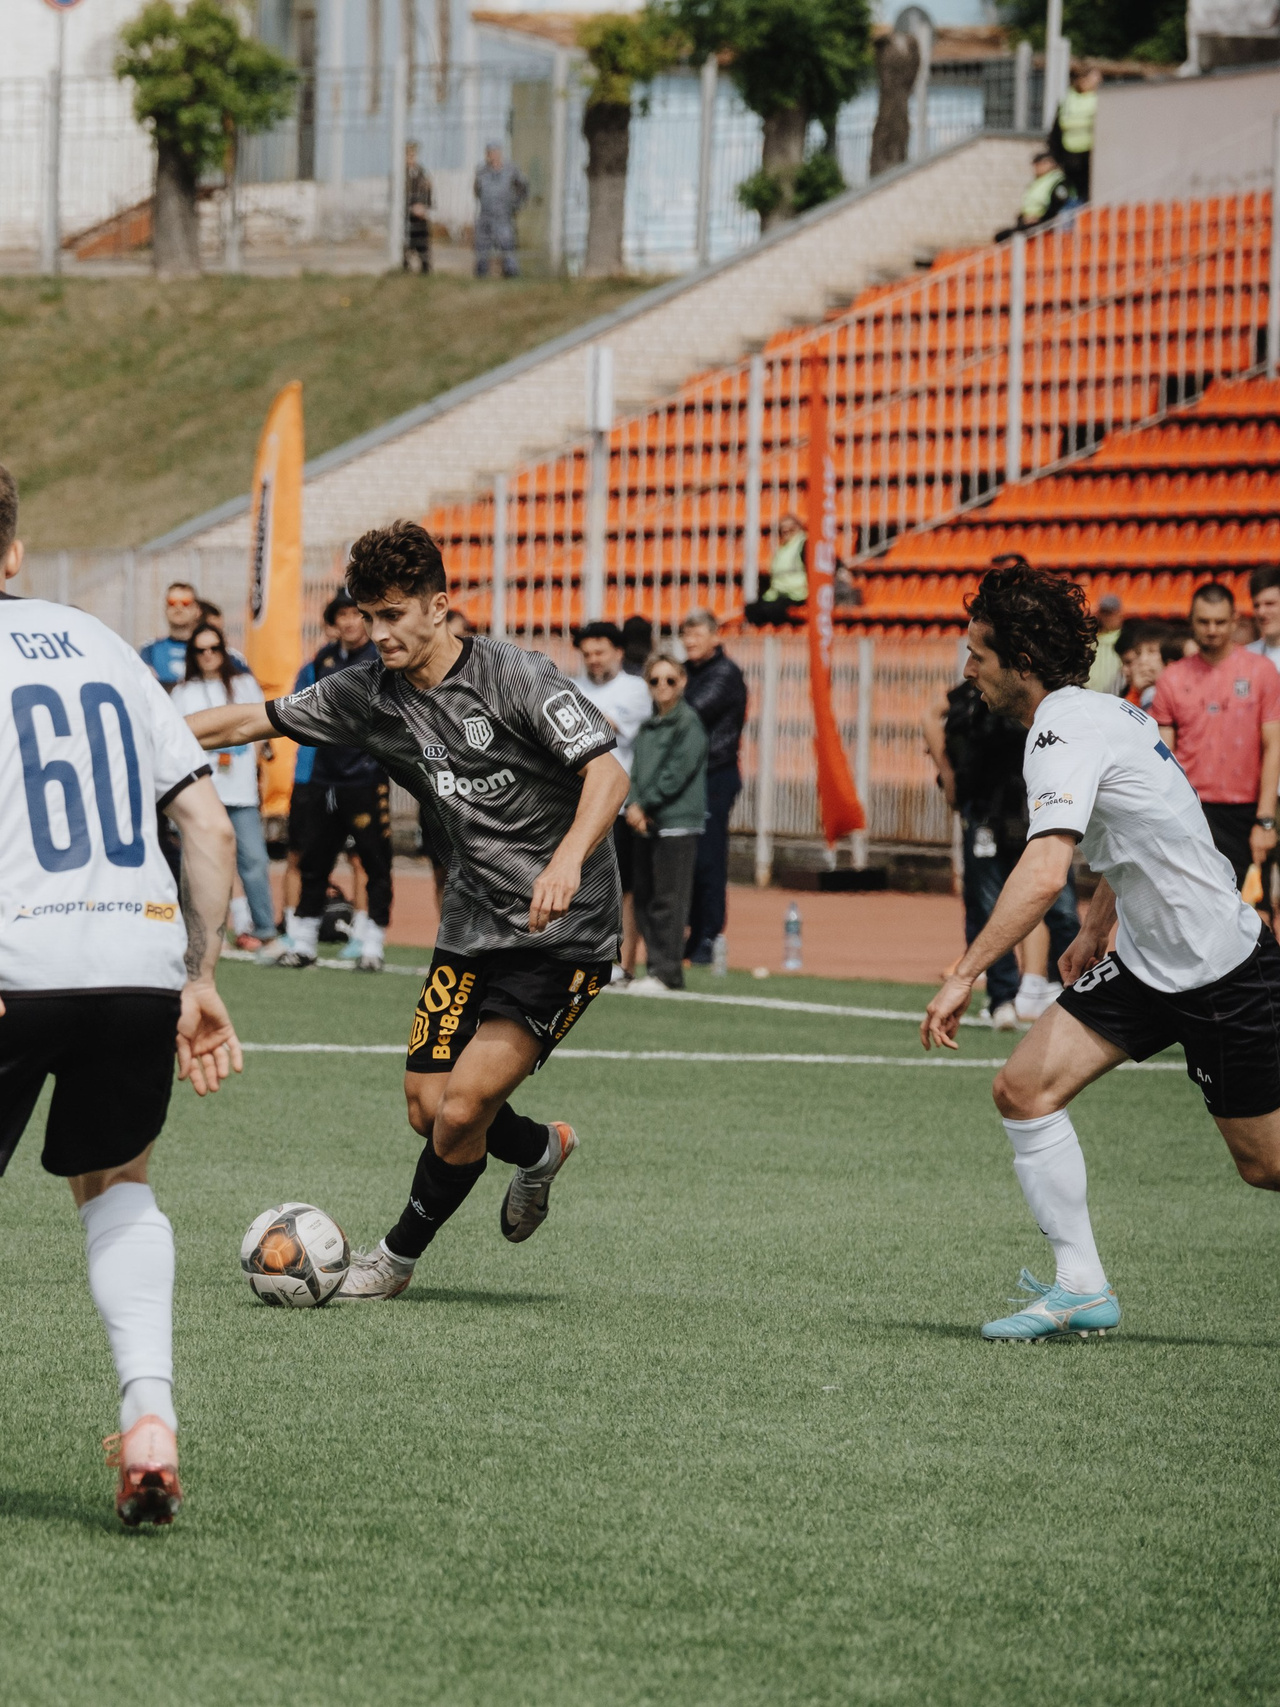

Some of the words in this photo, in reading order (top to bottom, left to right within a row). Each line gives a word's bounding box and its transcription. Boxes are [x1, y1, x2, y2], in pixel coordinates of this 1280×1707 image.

[11, 682, 146, 874] 60
[146, 904, 175, 920] PRO
[420, 964, 458, 1014] 8
[432, 971, 477, 1060] BetBoom
